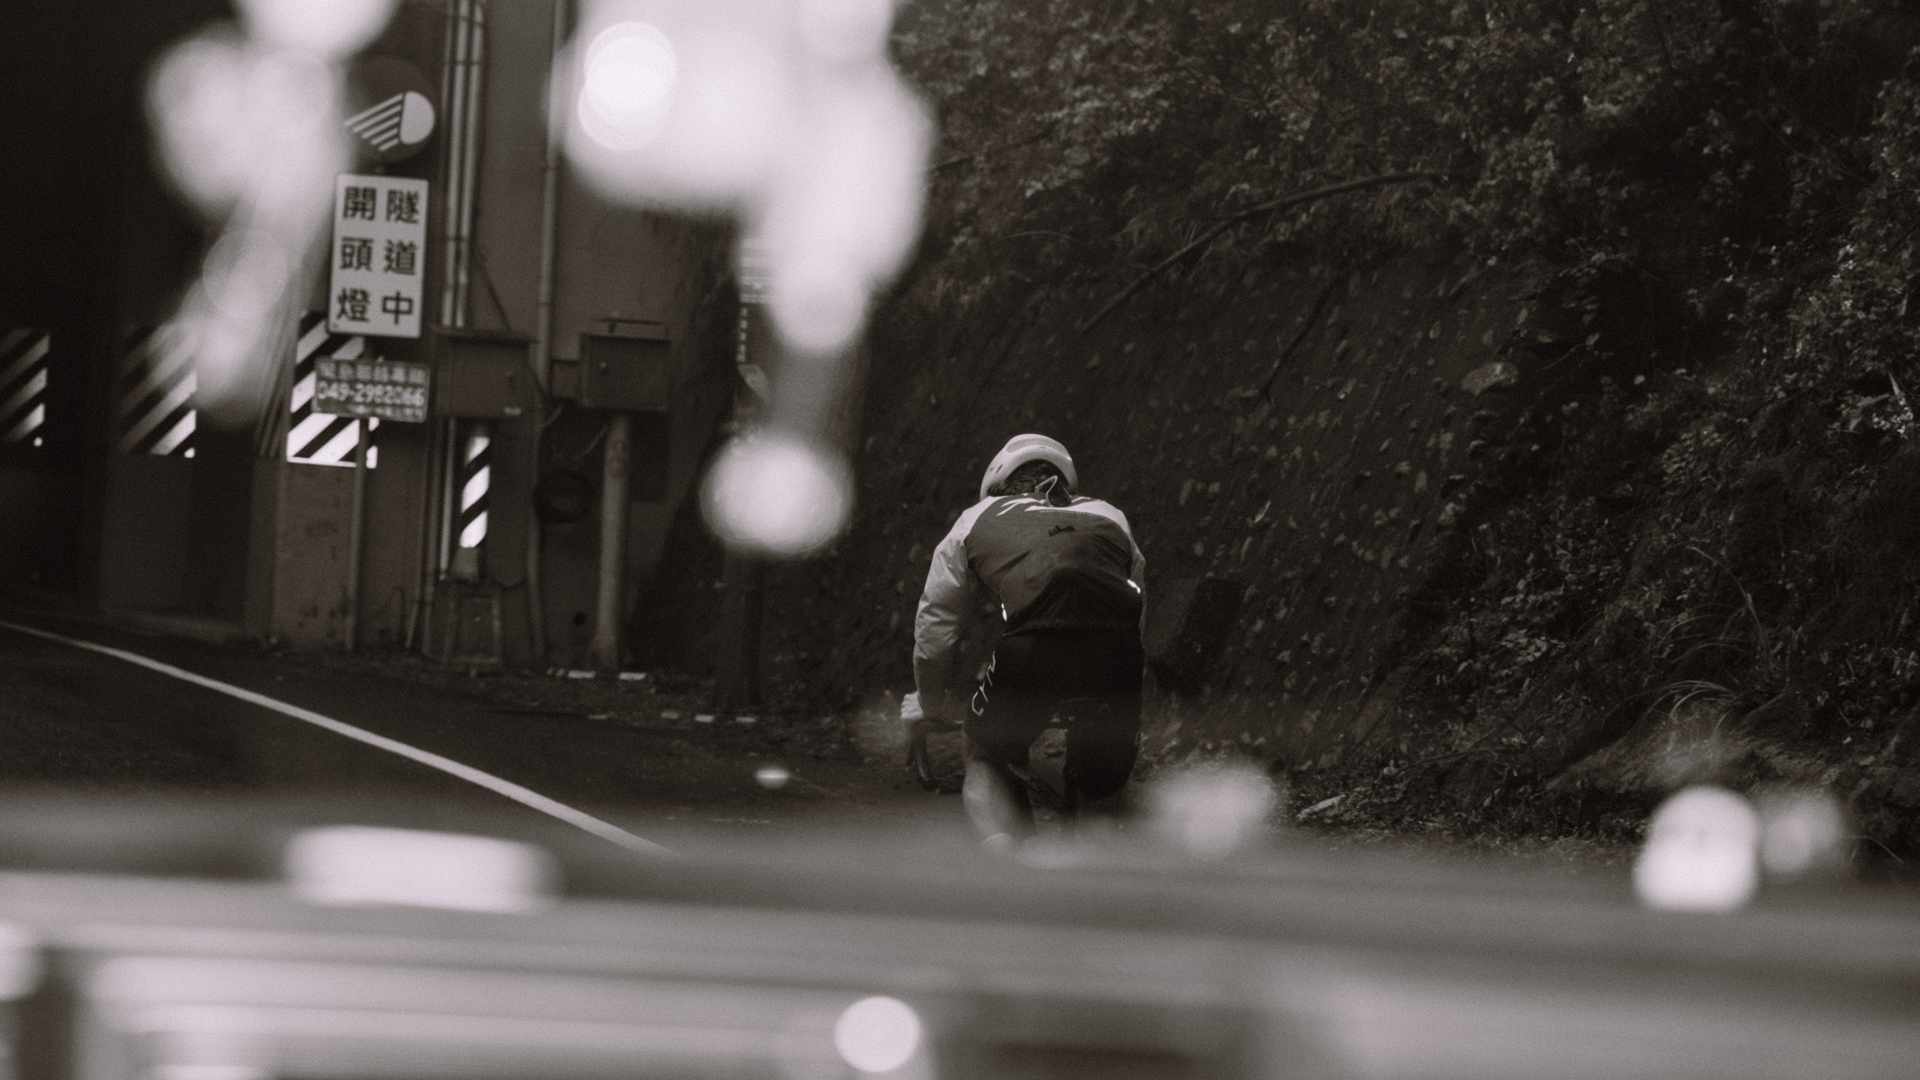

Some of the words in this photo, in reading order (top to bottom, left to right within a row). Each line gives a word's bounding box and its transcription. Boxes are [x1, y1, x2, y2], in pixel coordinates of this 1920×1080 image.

[337, 186, 377, 323] 開頭燈
[381, 189, 420, 325] 隧道中
